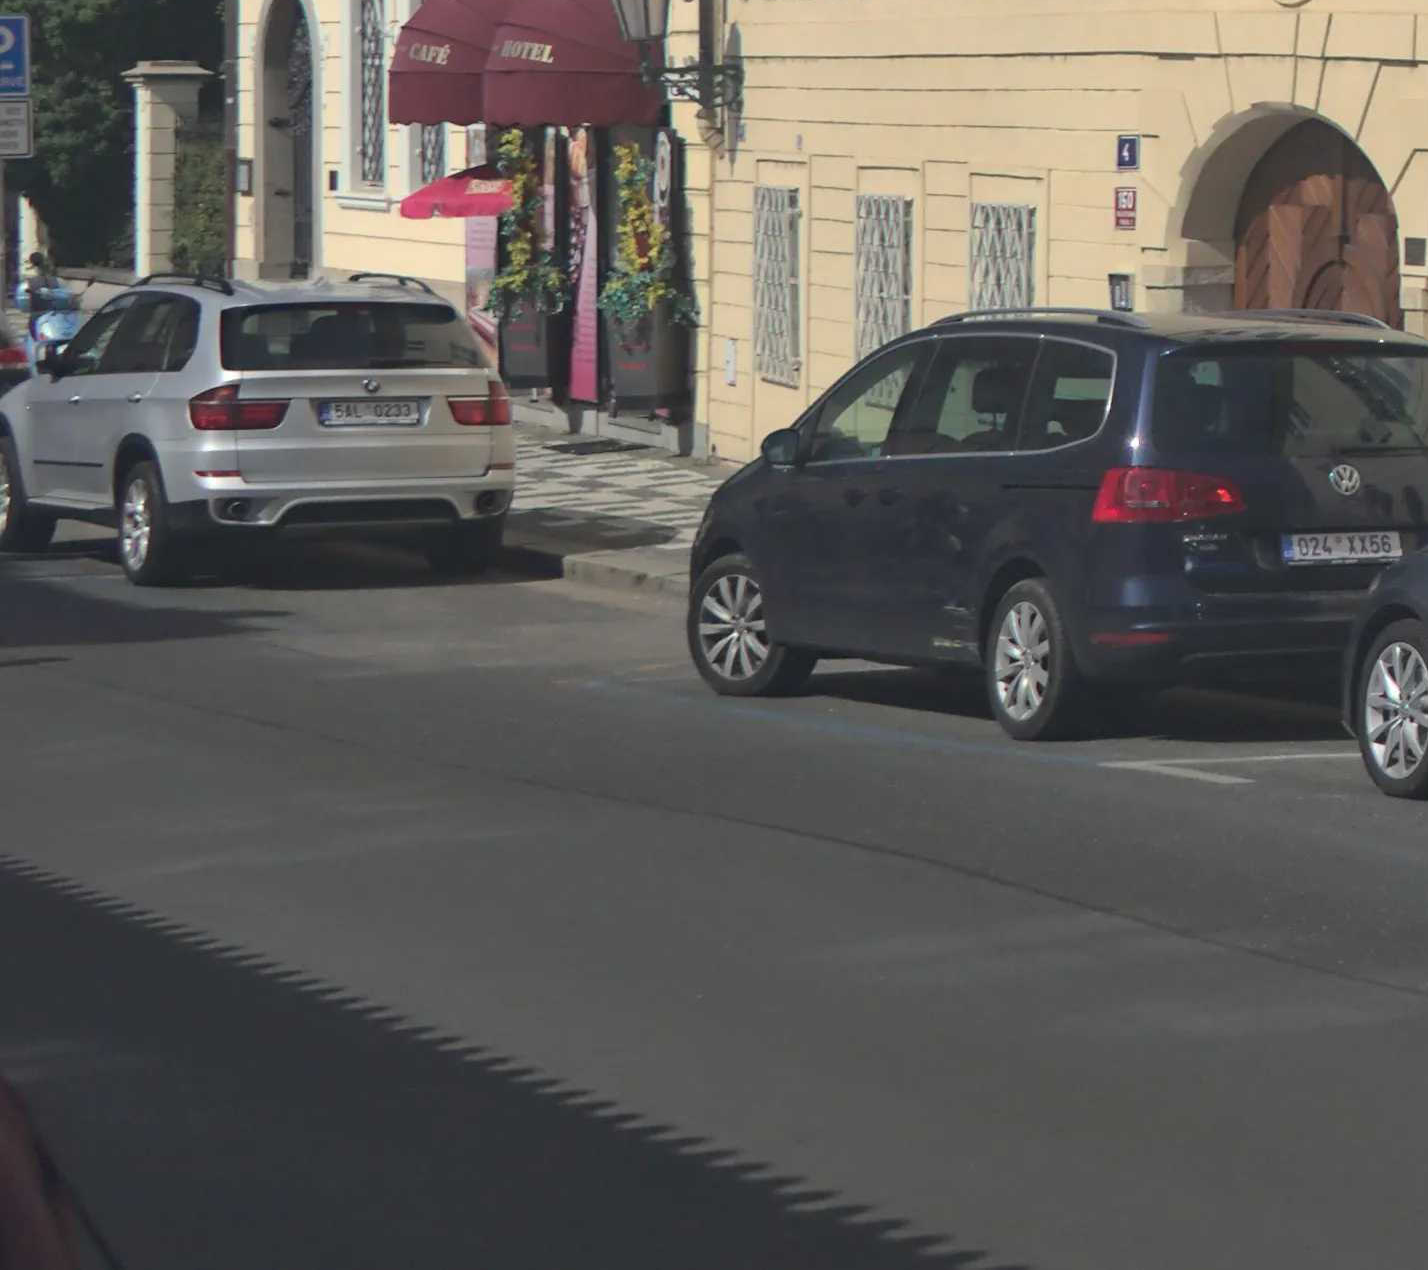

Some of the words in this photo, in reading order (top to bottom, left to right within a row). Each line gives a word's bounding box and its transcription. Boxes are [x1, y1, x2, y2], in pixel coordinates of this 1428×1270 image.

[409, 43, 450, 65] CAFÉ
[501, 40, 554, 63] HOTEL
[1122, 142, 1130, 162] 4
[334, 404, 362, 419] 5AL
[373, 403, 411, 418] 0233
[1298, 536, 1333, 557] 024
[1346, 534, 1393, 555] XX56
